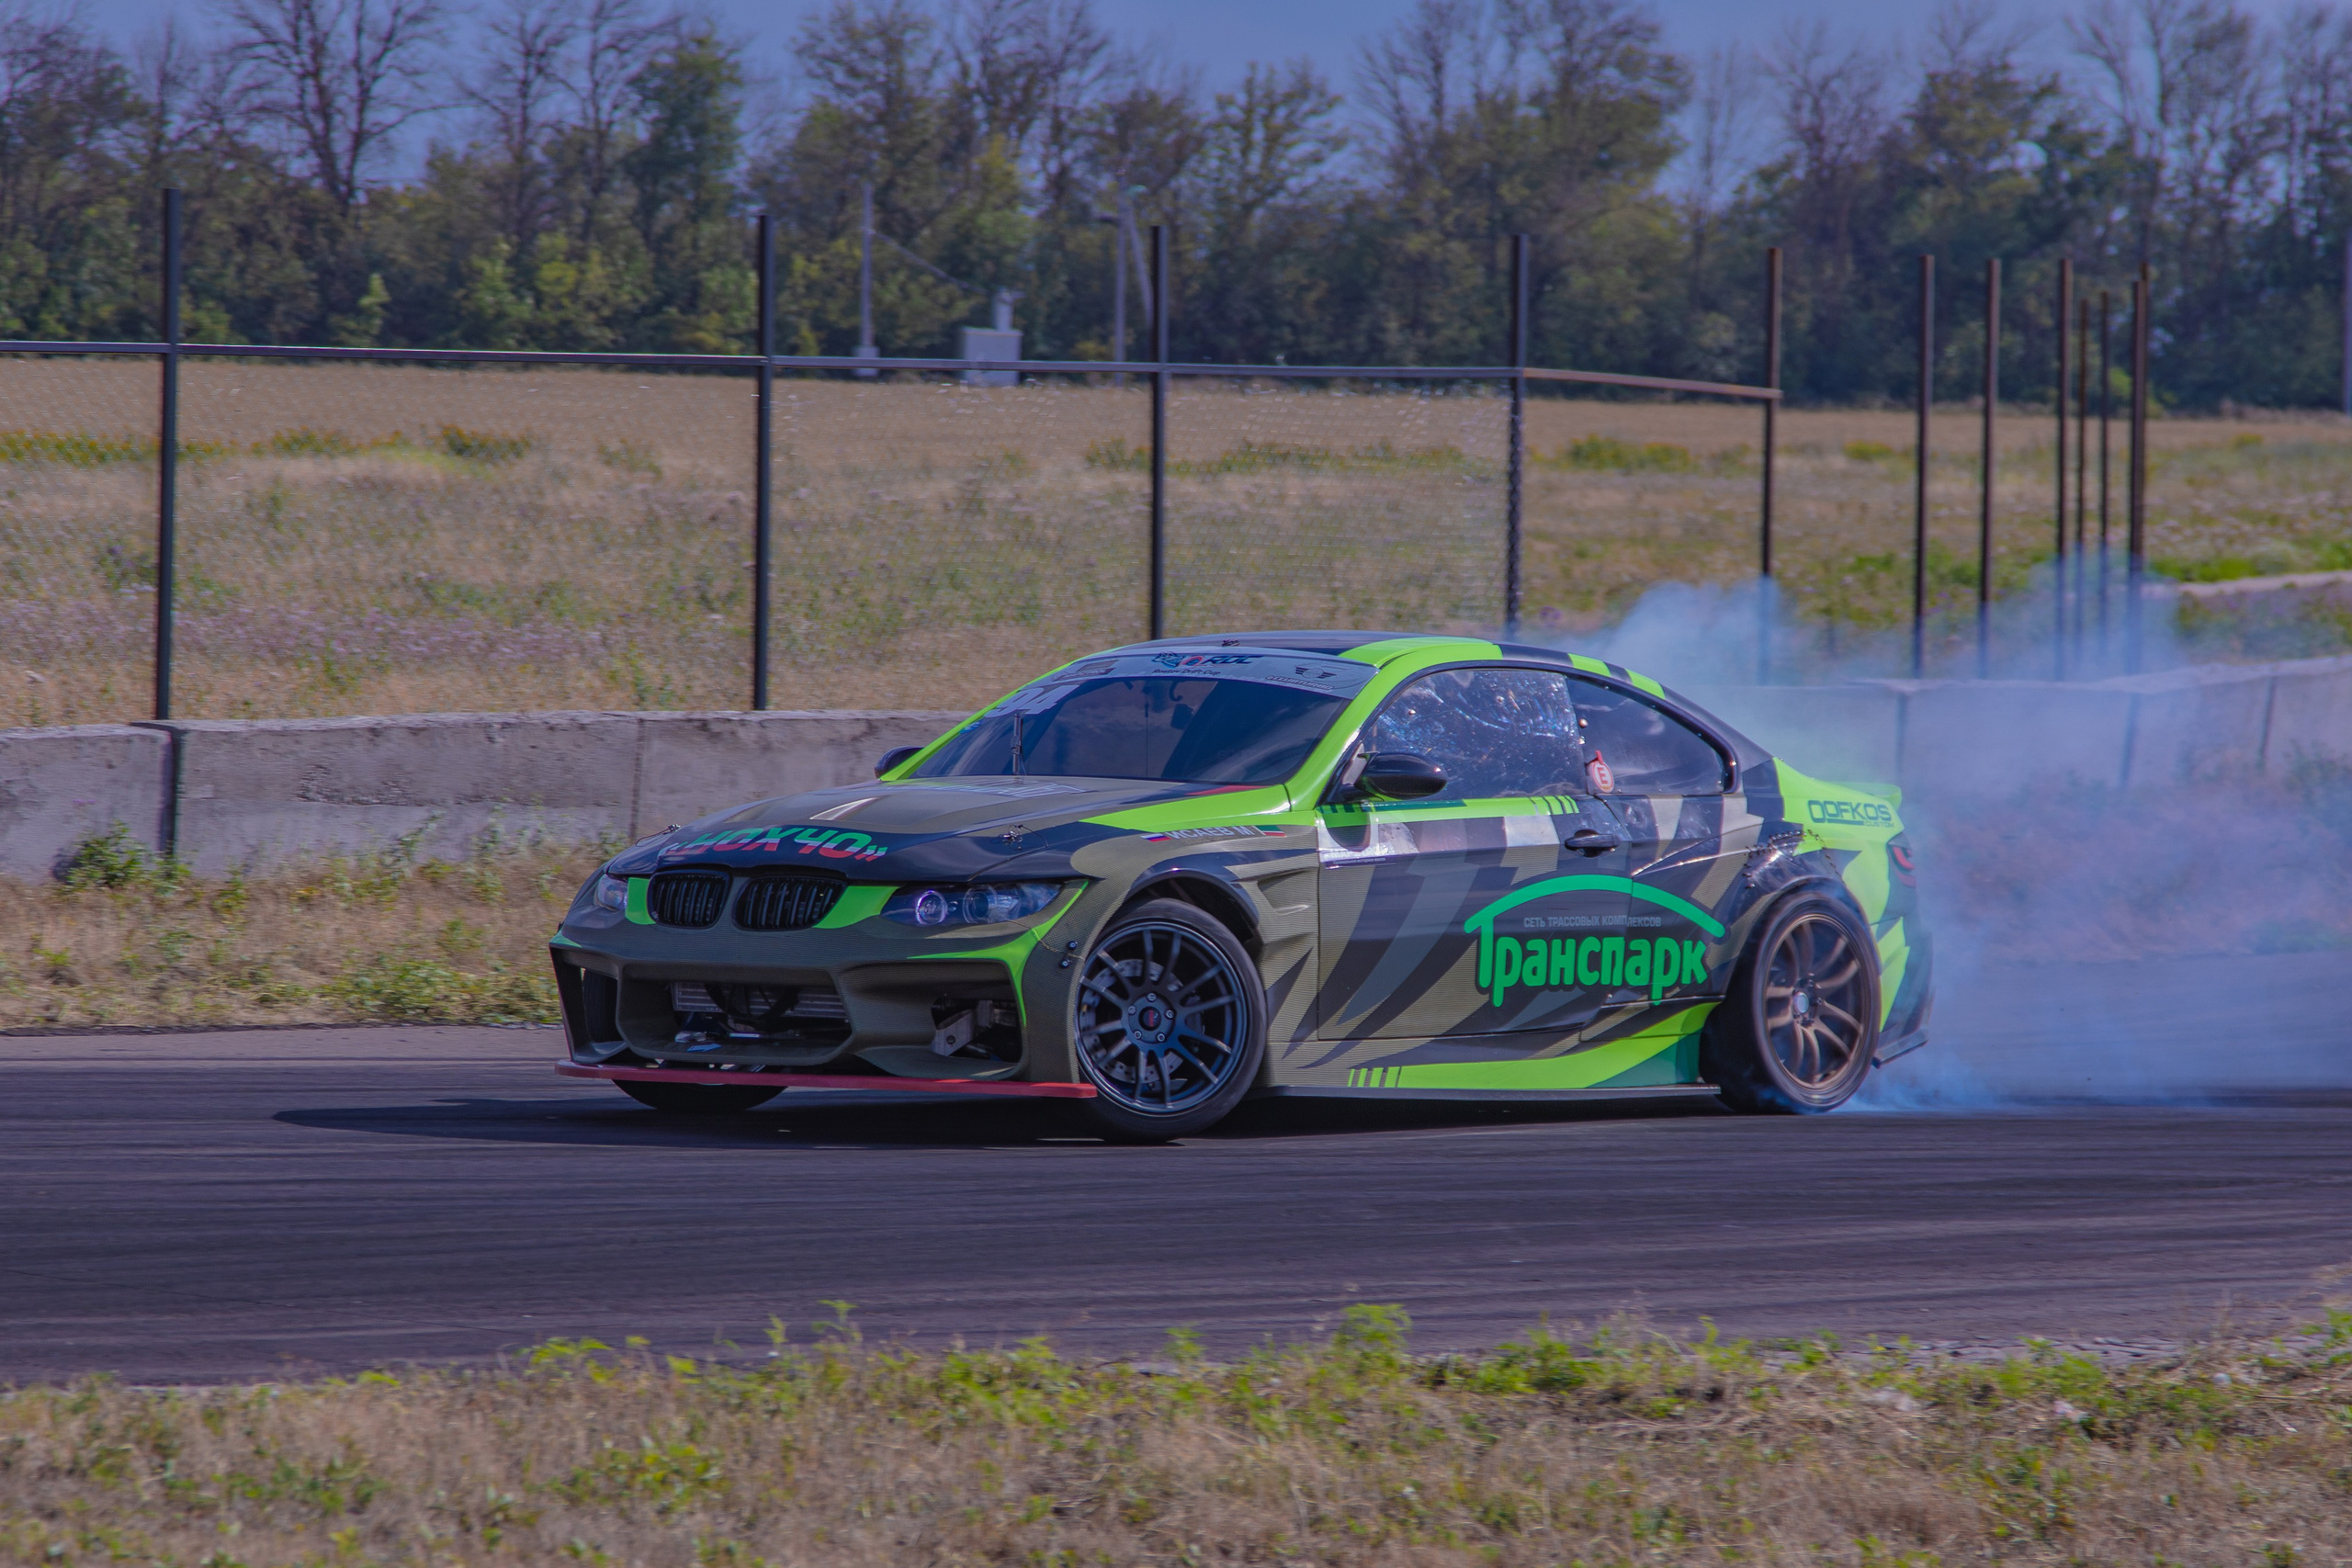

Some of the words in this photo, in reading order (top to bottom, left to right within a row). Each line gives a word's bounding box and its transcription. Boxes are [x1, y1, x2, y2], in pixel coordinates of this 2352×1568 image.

[983, 684, 1080, 718] 94
[1597, 767, 1609, 784] E
[1166, 827, 1235, 840] ИСАЕВ
[1232, 825, 1256, 836] М
[1523, 917, 1546, 928] СЕТЬ
[1548, 916, 1600, 928] ТРАССОВЫХ
[1601, 915, 1662, 928] КОМПЛЕКСОВ
